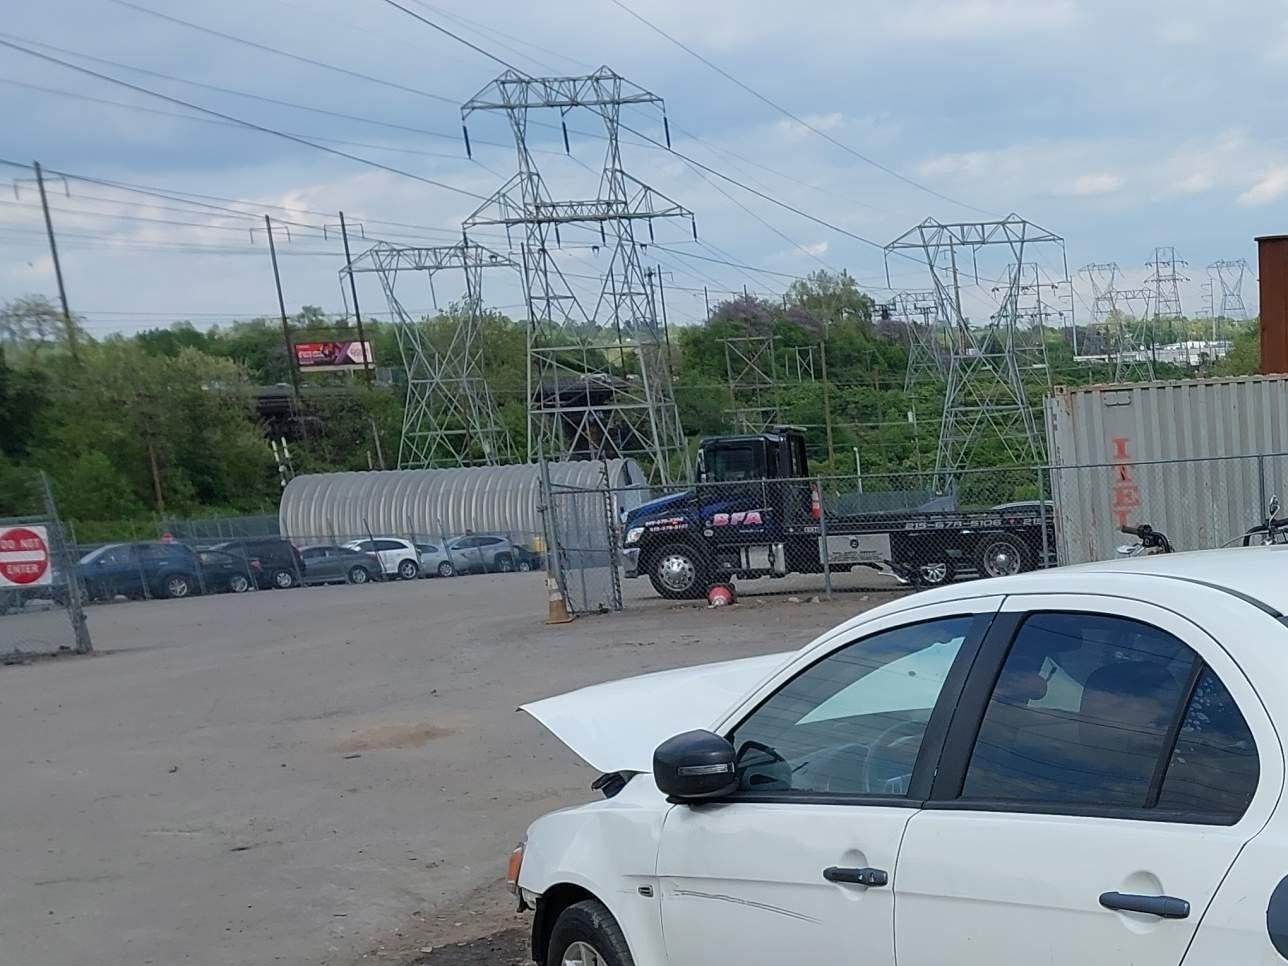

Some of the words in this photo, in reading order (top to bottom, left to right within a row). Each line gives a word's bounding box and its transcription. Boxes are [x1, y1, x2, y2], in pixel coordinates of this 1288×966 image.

[713, 512, 763, 526] BFA
[0, 539, 16, 550] DO
[20, 538, 41, 549] NOT
[7, 564, 38, 575] ENTER
